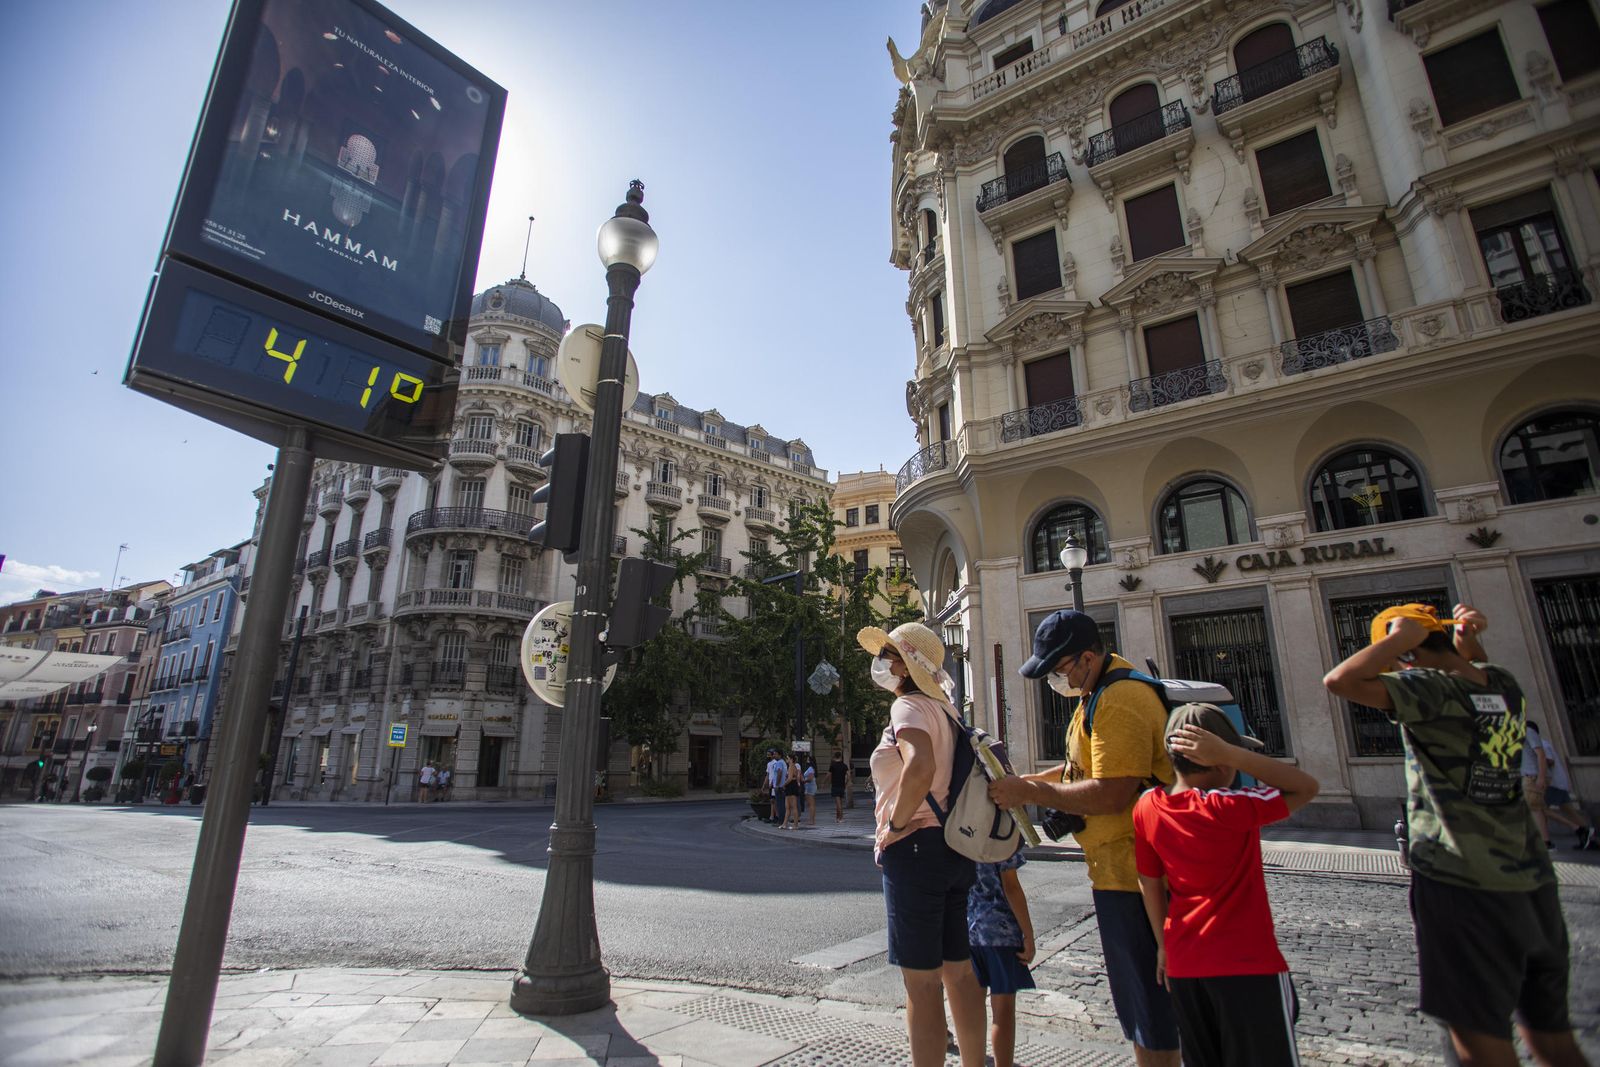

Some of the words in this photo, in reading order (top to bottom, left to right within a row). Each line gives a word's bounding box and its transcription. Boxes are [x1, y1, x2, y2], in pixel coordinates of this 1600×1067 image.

[334, 26, 345, 38] TU
[346, 34, 399, 73] NATURALEZA
[399, 69, 435, 96] INTERIOR
[282, 208, 398, 272] HAMMAM
[316, 241, 325, 249] AL
[308, 290, 365, 320] JCDecaux
[1236, 550, 1296, 571] CAJA
[1301, 537, 1394, 565] RURAL
